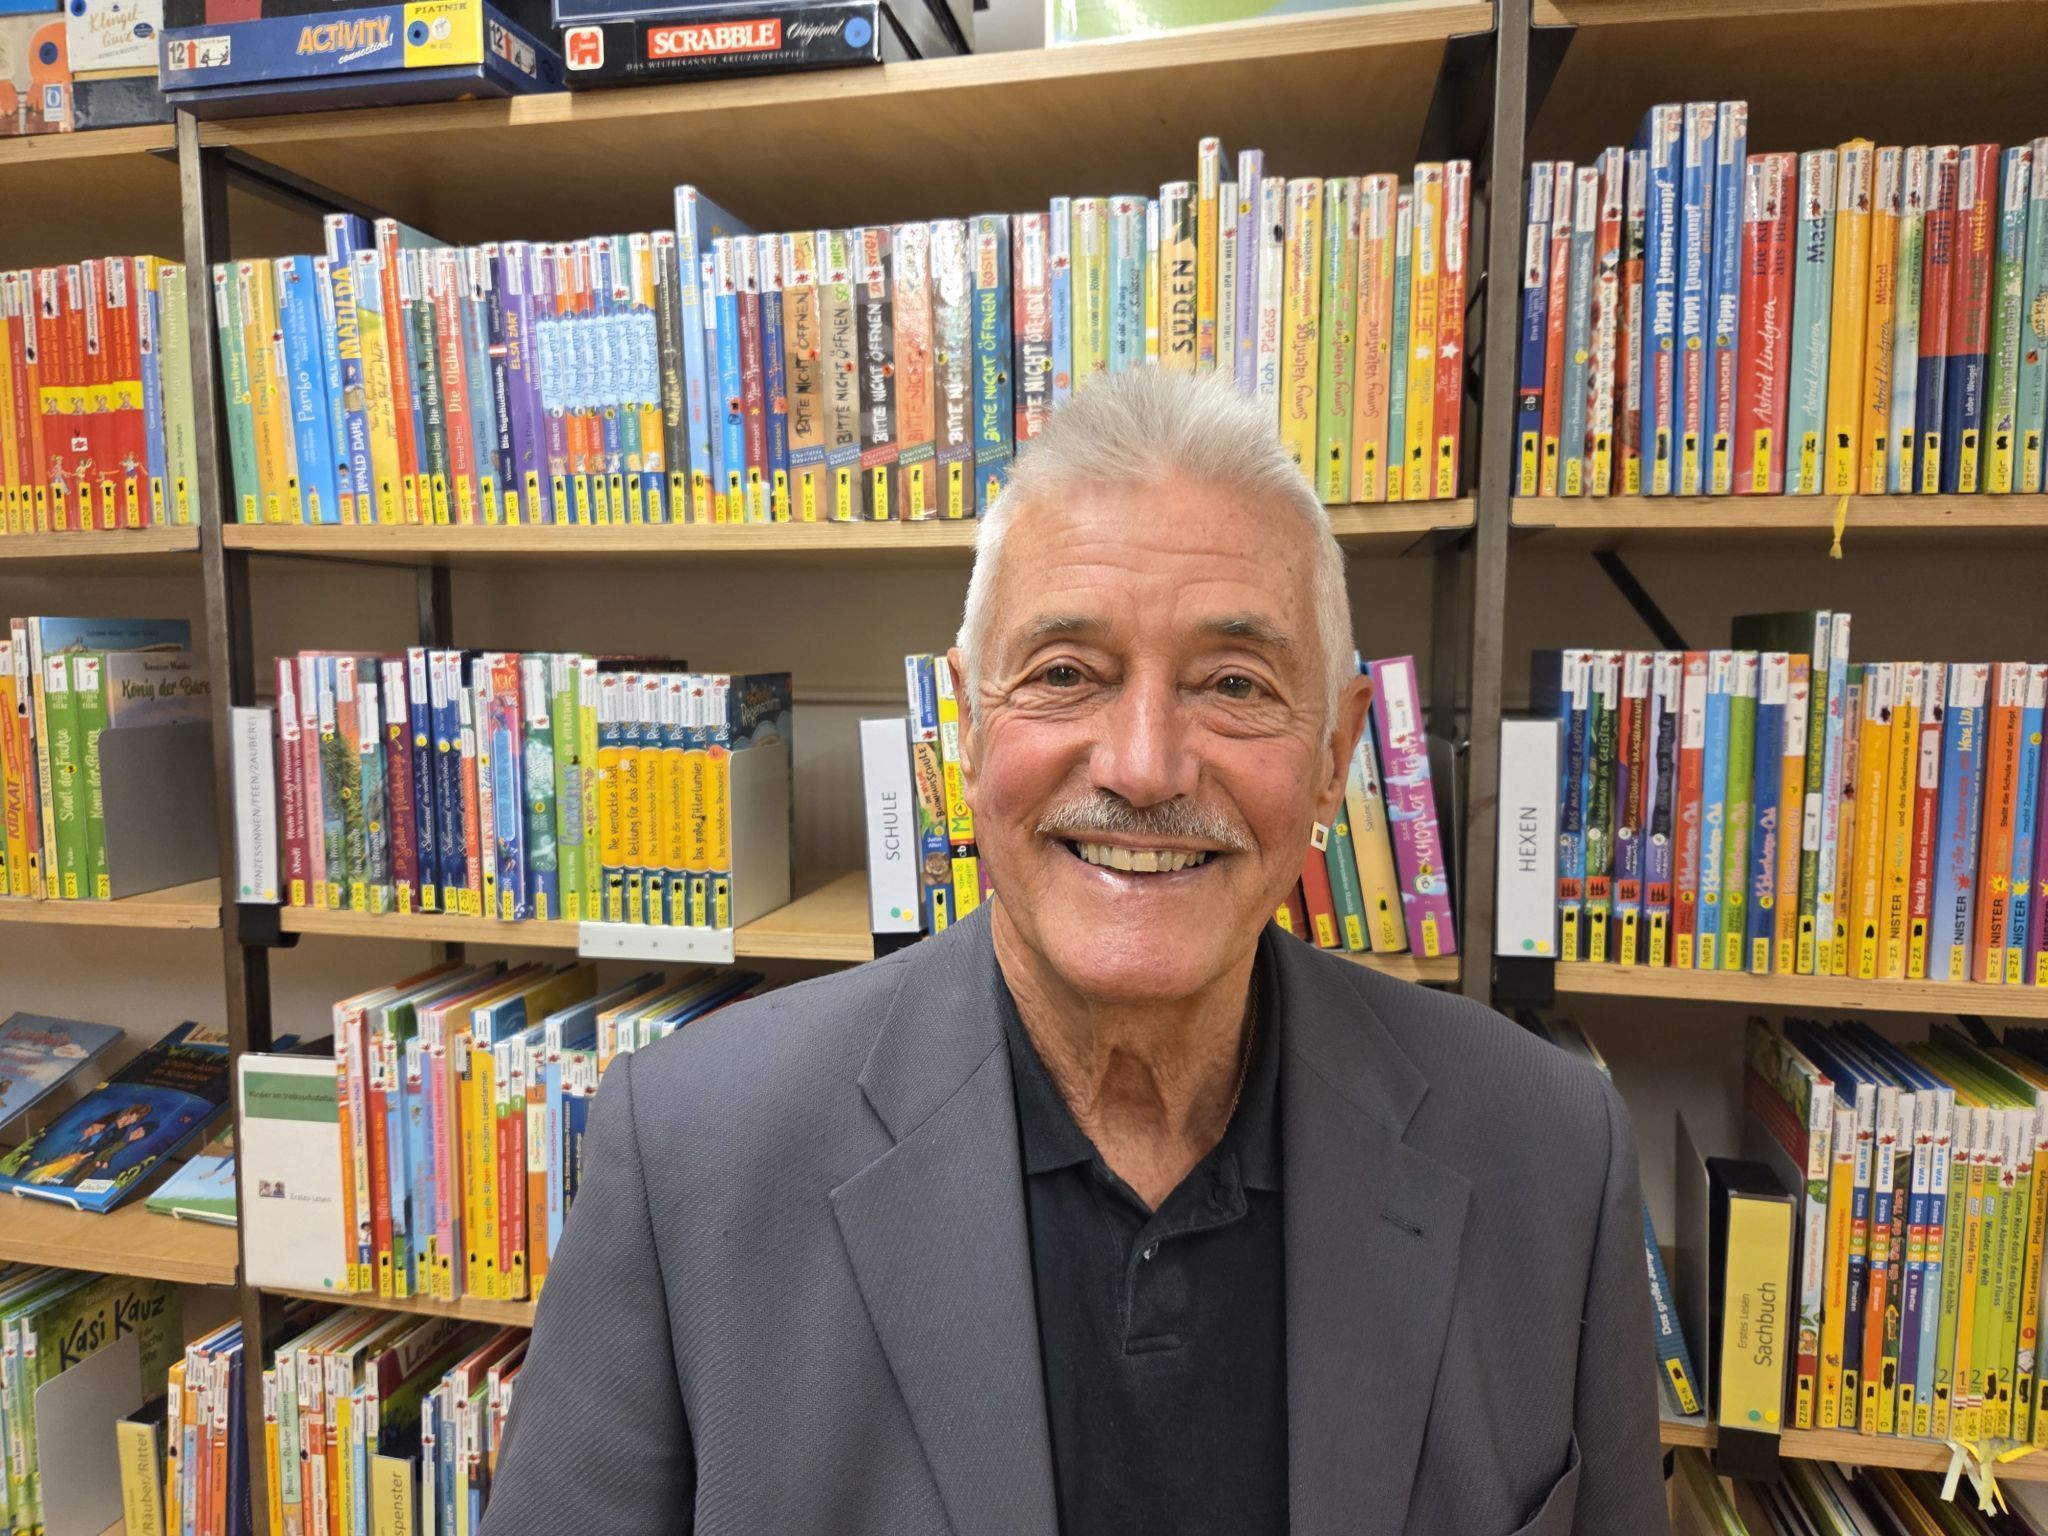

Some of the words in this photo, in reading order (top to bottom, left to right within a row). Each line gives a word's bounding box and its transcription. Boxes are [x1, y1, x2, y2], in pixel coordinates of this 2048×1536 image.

[413, 3, 467, 15] PIATNIK
[297, 16, 393, 55] ACTIVITY
[339, 34, 393, 67] connection!
[654, 21, 778, 56] SCRABBLE
[786, 17, 844, 48] Original
[169, 42, 186, 65] 12
[1654, 178, 1675, 285] Langstrumpf
[1722, 187, 1737, 275] Taka-Tuka-Land
[1970, 199, 1988, 252] weiter
[1683, 203, 1701, 292] Langstrumpf
[1876, 264, 1888, 305] Michel
[331, 267, 361, 360] MATILDA
[507, 309, 521, 338] ZART
[791, 290, 810, 350] ÖFFNEN
[977, 292, 996, 351] ÖFFNEN
[1172, 259, 1193, 355] SÜDEN
[1653, 290, 1674, 336] Pippi
[1681, 297, 1701, 336] Pippi
[1717, 294, 1736, 334] Pippi
[830, 308, 851, 360] ÖFFNEN
[865, 303, 885, 362] ÖFFNEN
[1260, 308, 1276, 353] Pieks
[1330, 320, 1346, 378] Valentine
[1363, 320, 1379, 378] Valentine
[1755, 297, 1783, 371] Lindgren
[1806, 322, 1824, 377] Lindgren
[1874, 320, 1891, 373] Lindgren
[441, 342, 460, 386] Olchis
[510, 342, 522, 370] ELSA
[1023, 345, 1045, 393] NICHT
[1290, 323, 1308, 381] Valentine
[795, 355, 811, 395] NICHT
[833, 361, 849, 402] NICHT
[871, 364, 887, 402] NICHT
[980, 354, 996, 400] NICHT
[1261, 363, 1276, 395] Floh
[1658, 355, 1671, 401] LINDGREN
[1687, 353, 1699, 400] LINDGREN
[1720, 353, 1732, 400] LINDGREN
[296, 371, 315, 422] Pembo
[448, 388, 462, 413] Die
[1294, 385, 1312, 420] Sunny
[1332, 382, 1349, 417] Sunny
[1364, 381, 1383, 418] Sunny
[1752, 373, 1775, 423] Astrid
[1803, 378, 1819, 417] Astrid
[1872, 375, 1888, 416] Astrid
[351, 418, 365, 451] DAHL
[795, 400, 812, 438] BITTE
[835, 404, 853, 446] BITTE
[873, 406, 889, 444] BITTE
[947, 401, 964, 444] BITTE
[982, 403, 1000, 443] BITTE
[354, 455, 368, 492] ROALD
[1757, 459, 1766, 487] LIND
[1803, 460, 1814, 490] LIND
[1838, 459, 1848, 488] LIND
[121, 678, 156, 702] König
[2006, 710, 2017, 730] Kopf
[54, 728, 73, 769] Füchse
[2004, 748, 2013, 762] auf
[606, 764, 619, 789] Stadt
[624, 758, 638, 785] Zebra
[2001, 763, 2012, 791] Schule
[7, 777, 21, 840] KIDKAT
[248, 715, 264, 897] PRINZESSINNEN/FEEN/ZAUBEREI
[607, 790, 619, 834] verrückte
[626, 804, 638, 819] für
[627, 786, 638, 802] das
[626, 821, 641, 856] Rettung
[693, 821, 706, 845] große
[881, 791, 900, 861] SCHULE
[1414, 811, 1434, 865] SCHOOL
[1518, 807, 1538, 872] HEXEN
[1890, 894, 1902, 939] NISTER
[1897, 748, 1909, 792] Geheimnis
[468, 855, 479, 891] NISTER
[693, 847, 705, 861] Das
[2011, 899, 2025, 948] NISTER
[1952, 1191, 1963, 1213] Mats
[2036, 1169, 2048, 1197] Ponys
[1878, 1198, 1888, 1223] Erstes
[1914, 1199, 1925, 1224] Erstes
[1952, 1214, 1962, 1229] und
[2013, 1190, 2025, 1216] Lottes
[2034, 1199, 2045, 1214] und
[1968, 1222, 1980, 1253] Geniale
[1982, 1220, 1994, 1250] Wunder
[2012, 1217, 2023, 1240] Reise
[2031, 1216, 2044, 1245] Pferde
[1948, 1244, 1959, 1269] retten
[1966, 1254, 1977, 1274] Tiere
[2009, 1240, 2021, 1264] durch
[1947, 1270, 1957, 1289] eine
[1980, 1266, 1990, 1286] Welt
[2008, 1265, 2019, 1280] den
[2028, 1254, 2040, 1295] Lesestart
[1651, 1282, 1669, 1313] große
[1738, 1293, 1751, 1320] Lesen
[1944, 1289, 1956, 1315] Robbe
[2005, 1281, 2018, 1323] Dschungel
[2026, 1296, 2038, 1316] Dein
[59, 1308, 106, 1373] Kasi
[114, 1292, 166, 1341] Kauz
[1661, 1314, 1673, 1336] Das
[1738, 1321, 1750, 1350] Erstes
[1753, 1282, 1777, 1367] Sachbuch
[390, 1471, 407, 1536] spenster
